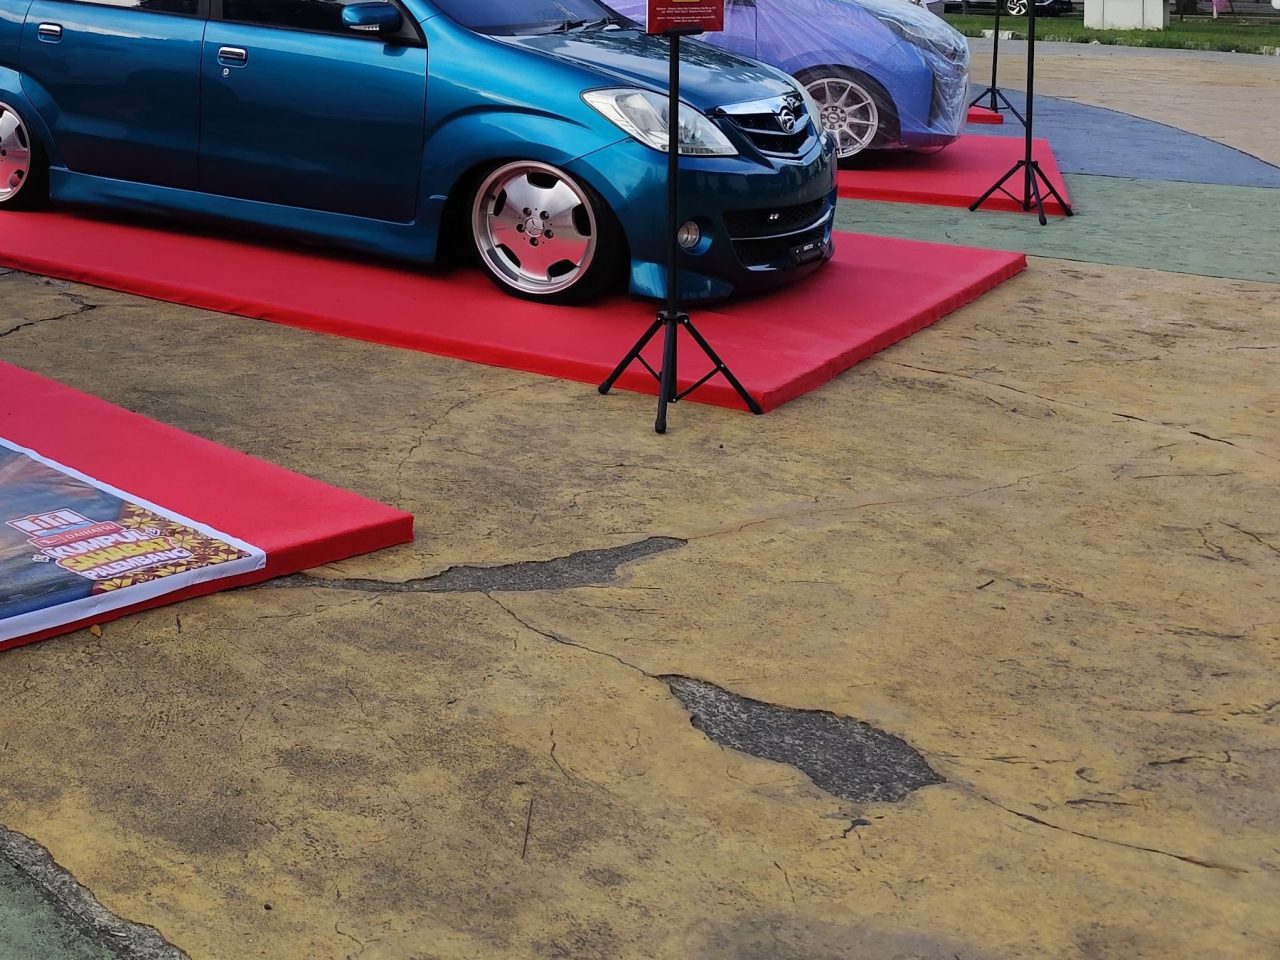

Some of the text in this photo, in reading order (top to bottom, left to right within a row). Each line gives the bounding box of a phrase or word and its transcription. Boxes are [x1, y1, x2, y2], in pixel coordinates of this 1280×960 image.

[45, 528, 150, 558] KUMPUL
[65, 523, 116, 539] DAIHATSU
[61, 537, 171, 571] SAHABAT
[83, 548, 192, 580] PALEMBANG
